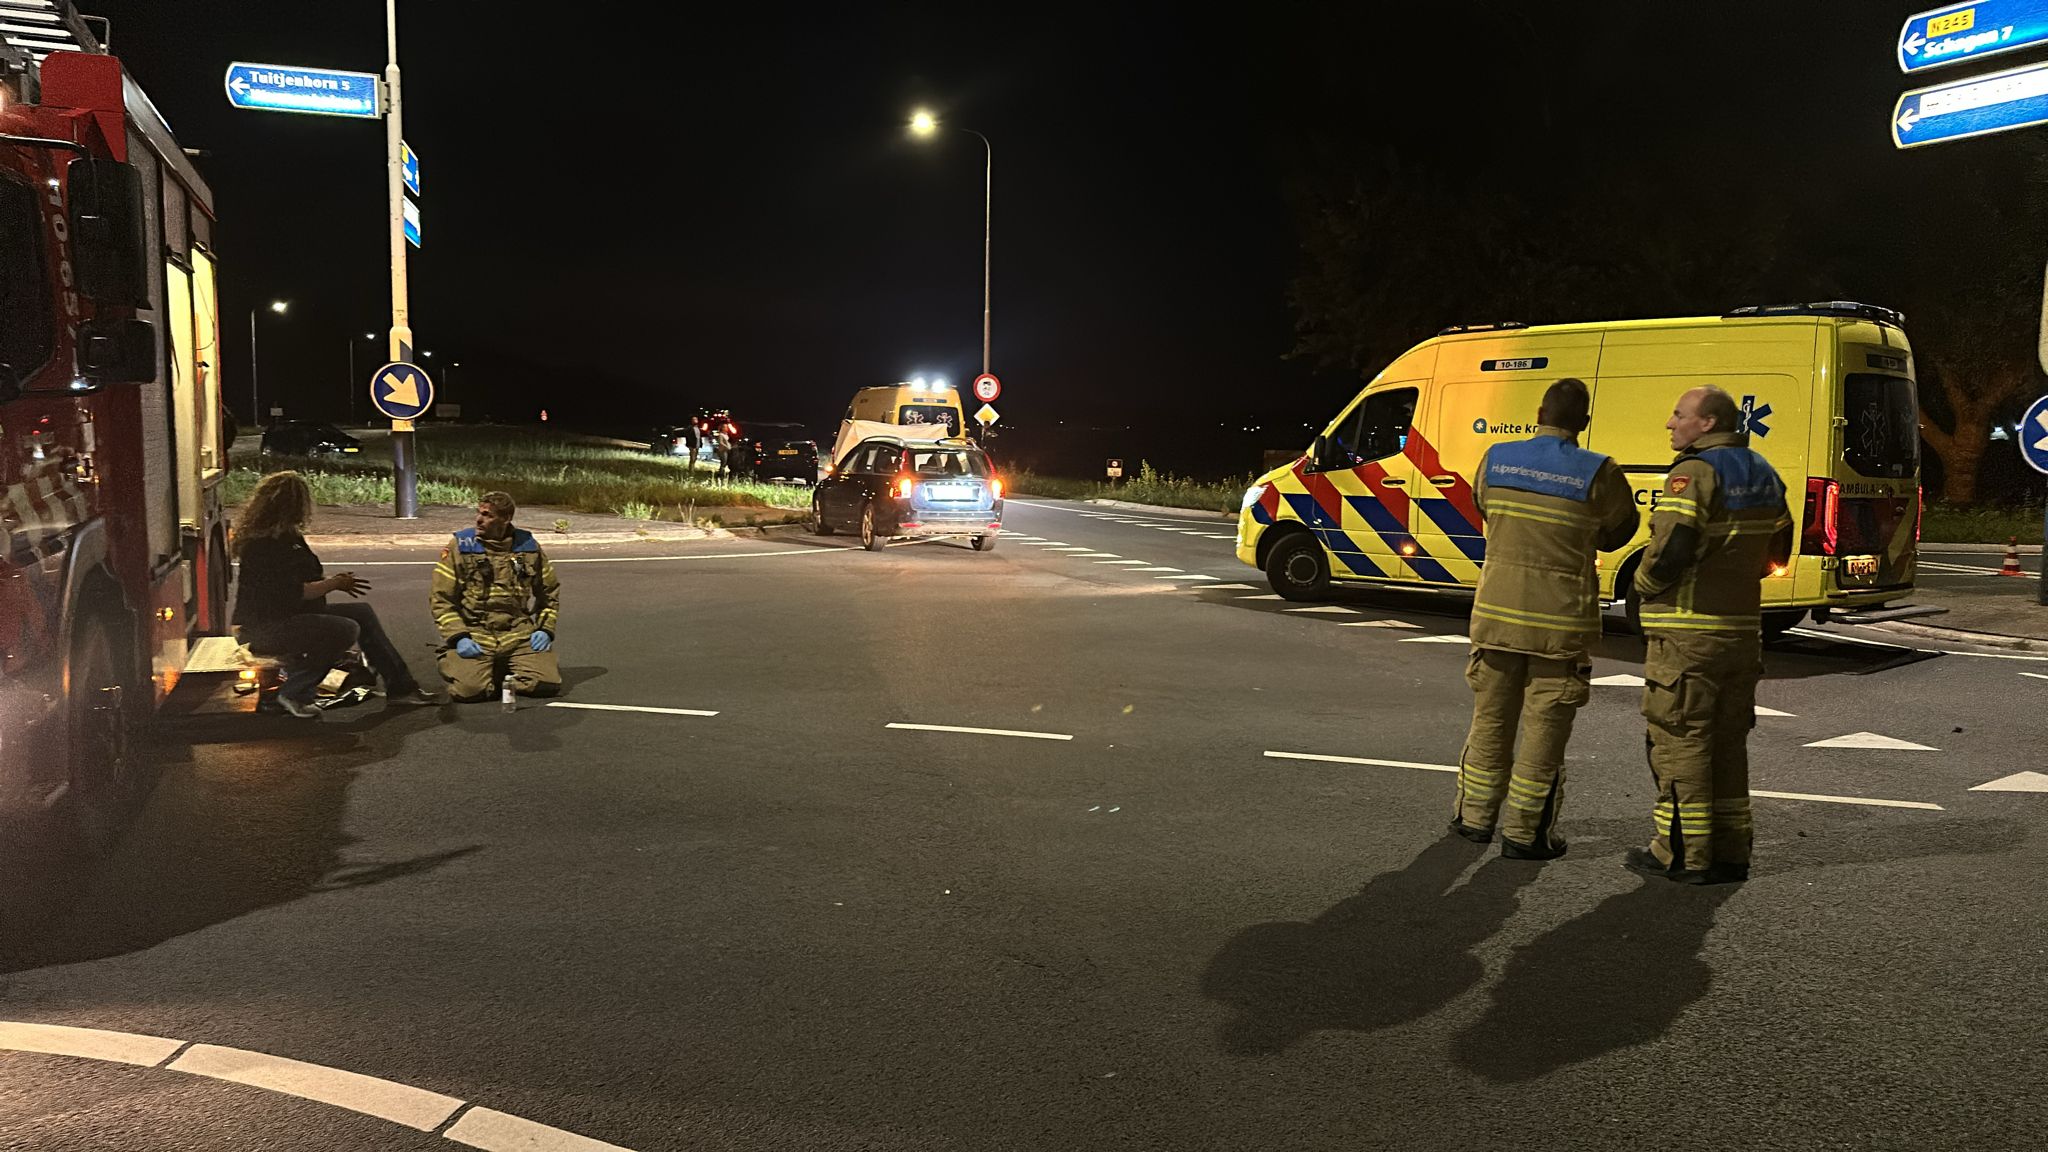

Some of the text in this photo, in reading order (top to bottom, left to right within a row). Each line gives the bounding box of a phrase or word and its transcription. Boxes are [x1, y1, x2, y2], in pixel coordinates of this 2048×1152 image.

[1930, 14, 1969, 33] N245
[249, 71, 338, 90] Tuitjenhorn
[1501, 361, 1528, 369] 10-186
[1490, 423, 1522, 434] witte
